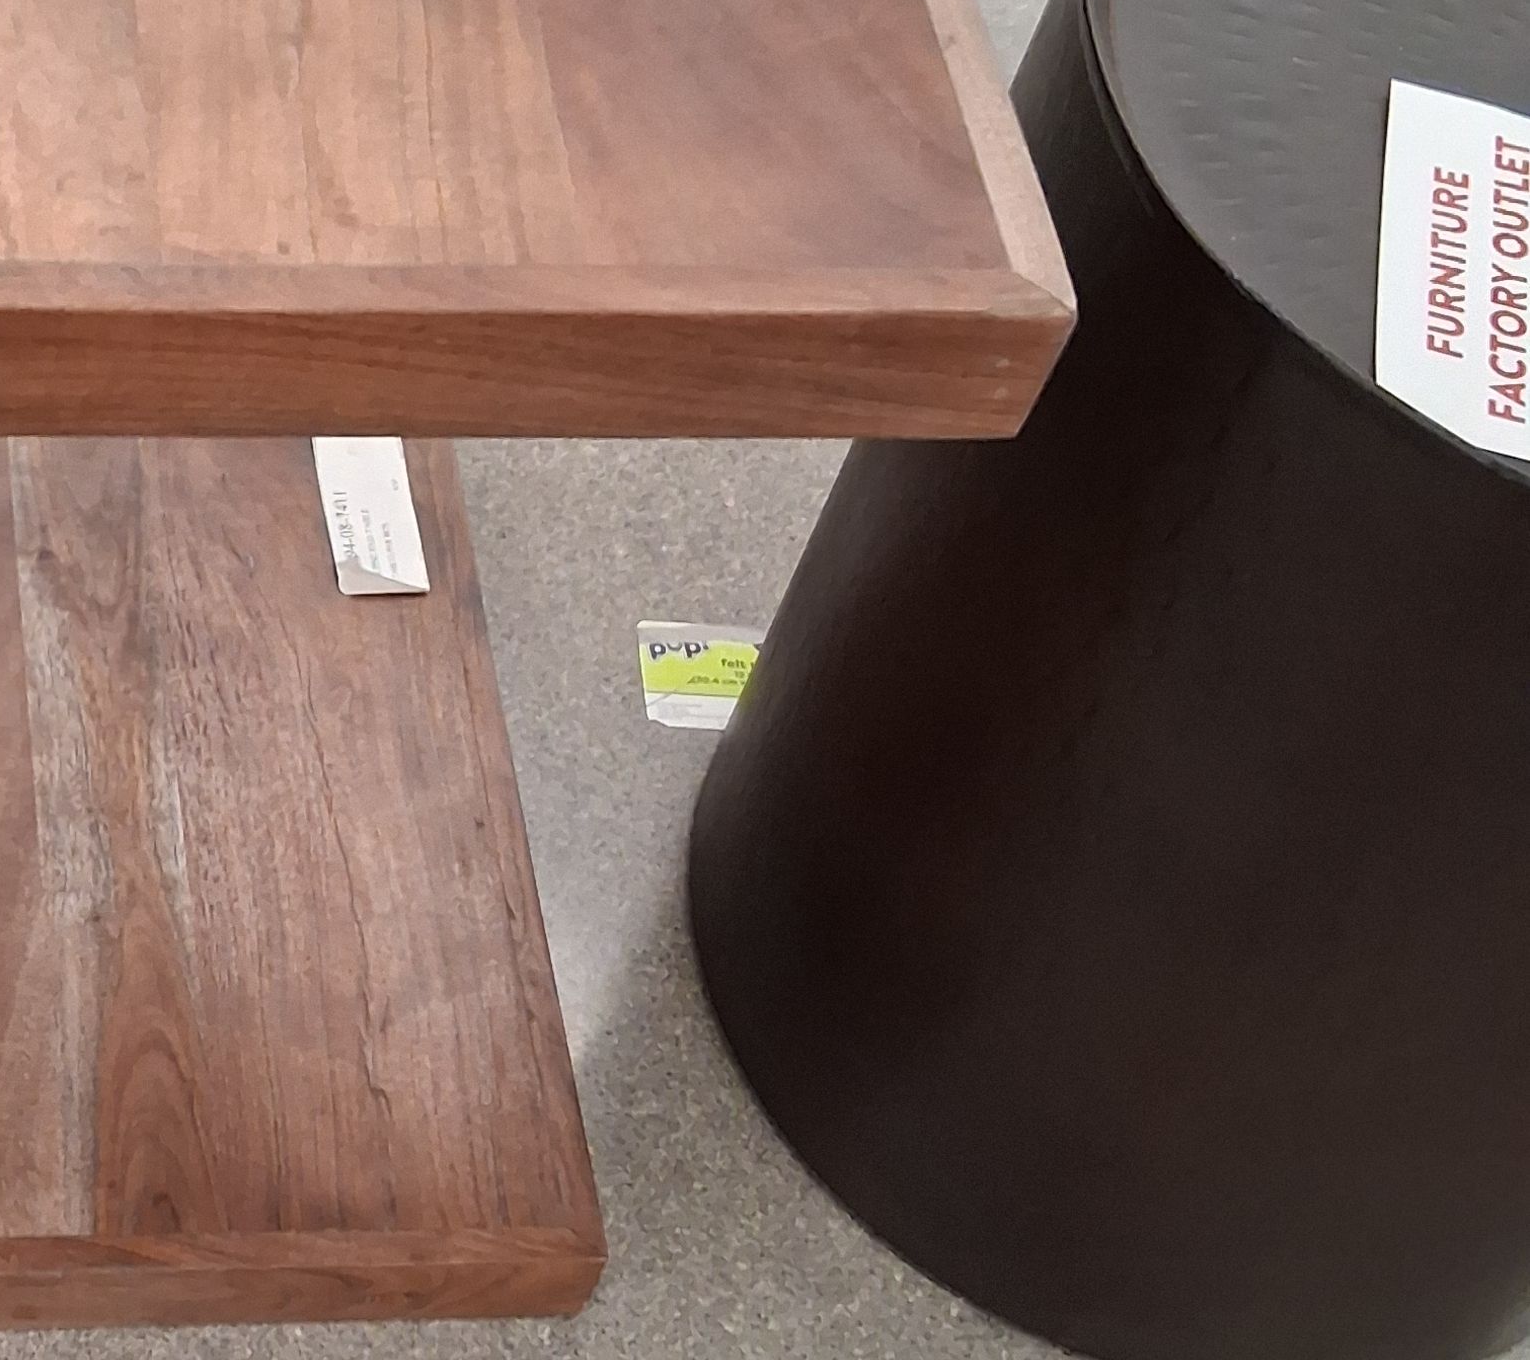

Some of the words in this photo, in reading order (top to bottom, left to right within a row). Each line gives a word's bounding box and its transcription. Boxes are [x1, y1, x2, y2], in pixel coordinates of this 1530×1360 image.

[1426, 167, 1469, 358] FURNITURE
[1491, 136, 1530, 259] OUTLET
[1488, 263, 1528, 424] FACTORY
[721, 658, 746, 669] felt
